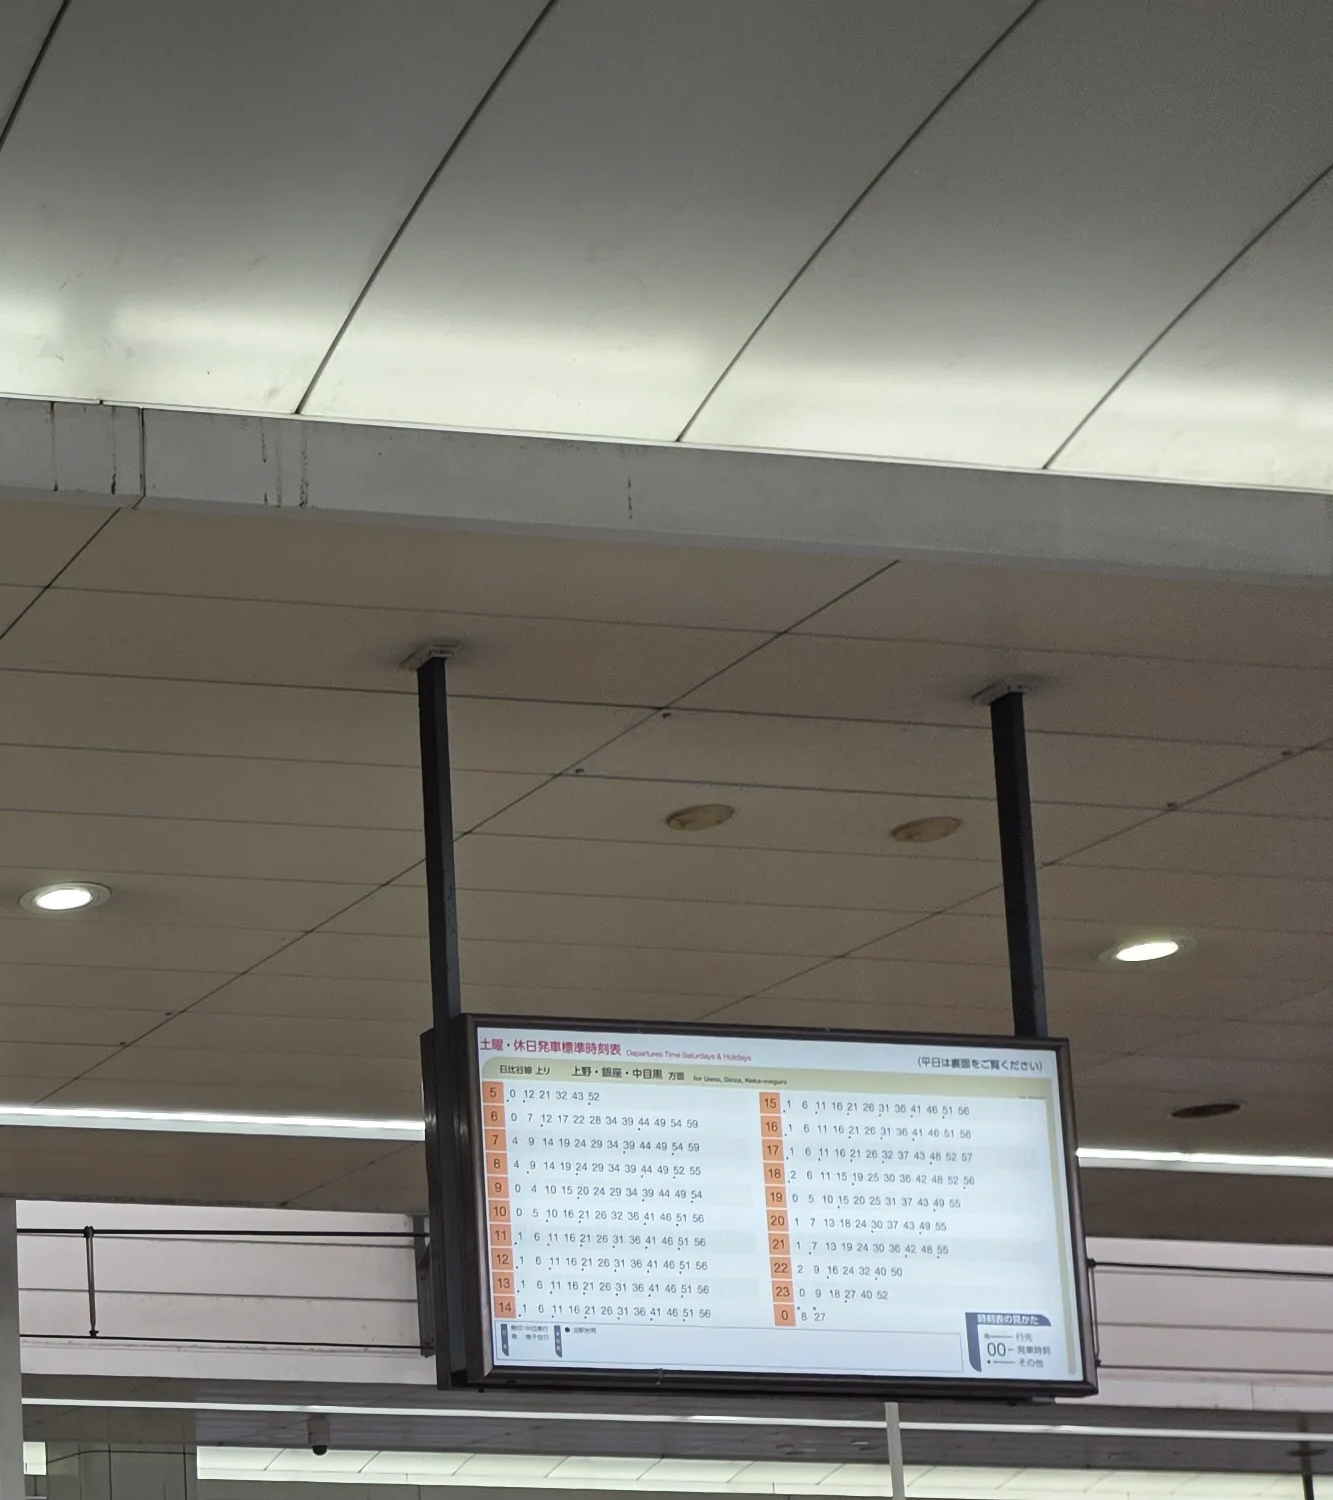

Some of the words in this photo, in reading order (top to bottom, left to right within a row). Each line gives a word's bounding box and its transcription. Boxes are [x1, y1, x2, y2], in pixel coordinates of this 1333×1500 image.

[490, 1087, 497, 1098] 5
[510, 1089, 516, 1098] 0
[524, 1090, 535, 1099] 12
[539, 1090, 550, 1099] 21
[556, 1091, 567, 1100] 32
[572, 1092, 584, 1100] 43
[588, 1092, 600, 1101] 52
[764, 1098, 777, 1109] 15
[490, 1111, 498, 1121] 6
[510, 1113, 518, 1122] 0
[527, 1113, 533, 1123] 7
[541, 1114, 553, 1123] 12
[558, 1115, 569, 1124] 17
[573, 1115, 585, 1124] 22
[589, 1116, 601, 1125] 28
[605, 1116, 617, 1126] 34
[621, 1117, 634, 1126] 39
[637, 1117, 650, 1126] 44
[654, 1118, 666, 1127] 49
[670, 1119, 682, 1128] 54
[686, 1119, 698, 1129] 59
[765, 1121, 778, 1132] 16
[492, 1135, 499, 1145] 7
[767, 1145, 779, 1155] 17
[493, 1158, 501, 1169] 8
[768, 1169, 782, 1179] 18
[494, 1182, 502, 1193] 9
[770, 1191, 783, 1202] 19
[493, 1206, 507, 1216] 10
[770, 1215, 785, 1226] 20
[494, 1230, 507, 1240] 11
[772, 1239, 785, 1250] 21
[496, 1254, 509, 1264] 12
[774, 1263, 788, 1273] 22
[497, 1278, 511, 1289] 13
[775, 1286, 790, 1297] 23
[799, 1289, 806, 1298] 0
[815, 1289, 822, 1298] 9
[829, 1289, 841, 1299] 18
[844, 1290, 856, 1299] 27
[861, 1290, 873, 1299] 40
[876, 1290, 889, 1300] 52
[499, 1302, 512, 1313] 14
[781, 1310, 789, 1321] 0
[801, 1313, 808, 1321] 8
[814, 1313, 826, 1322] 27
[987, 1342, 1006, 1357] 00
